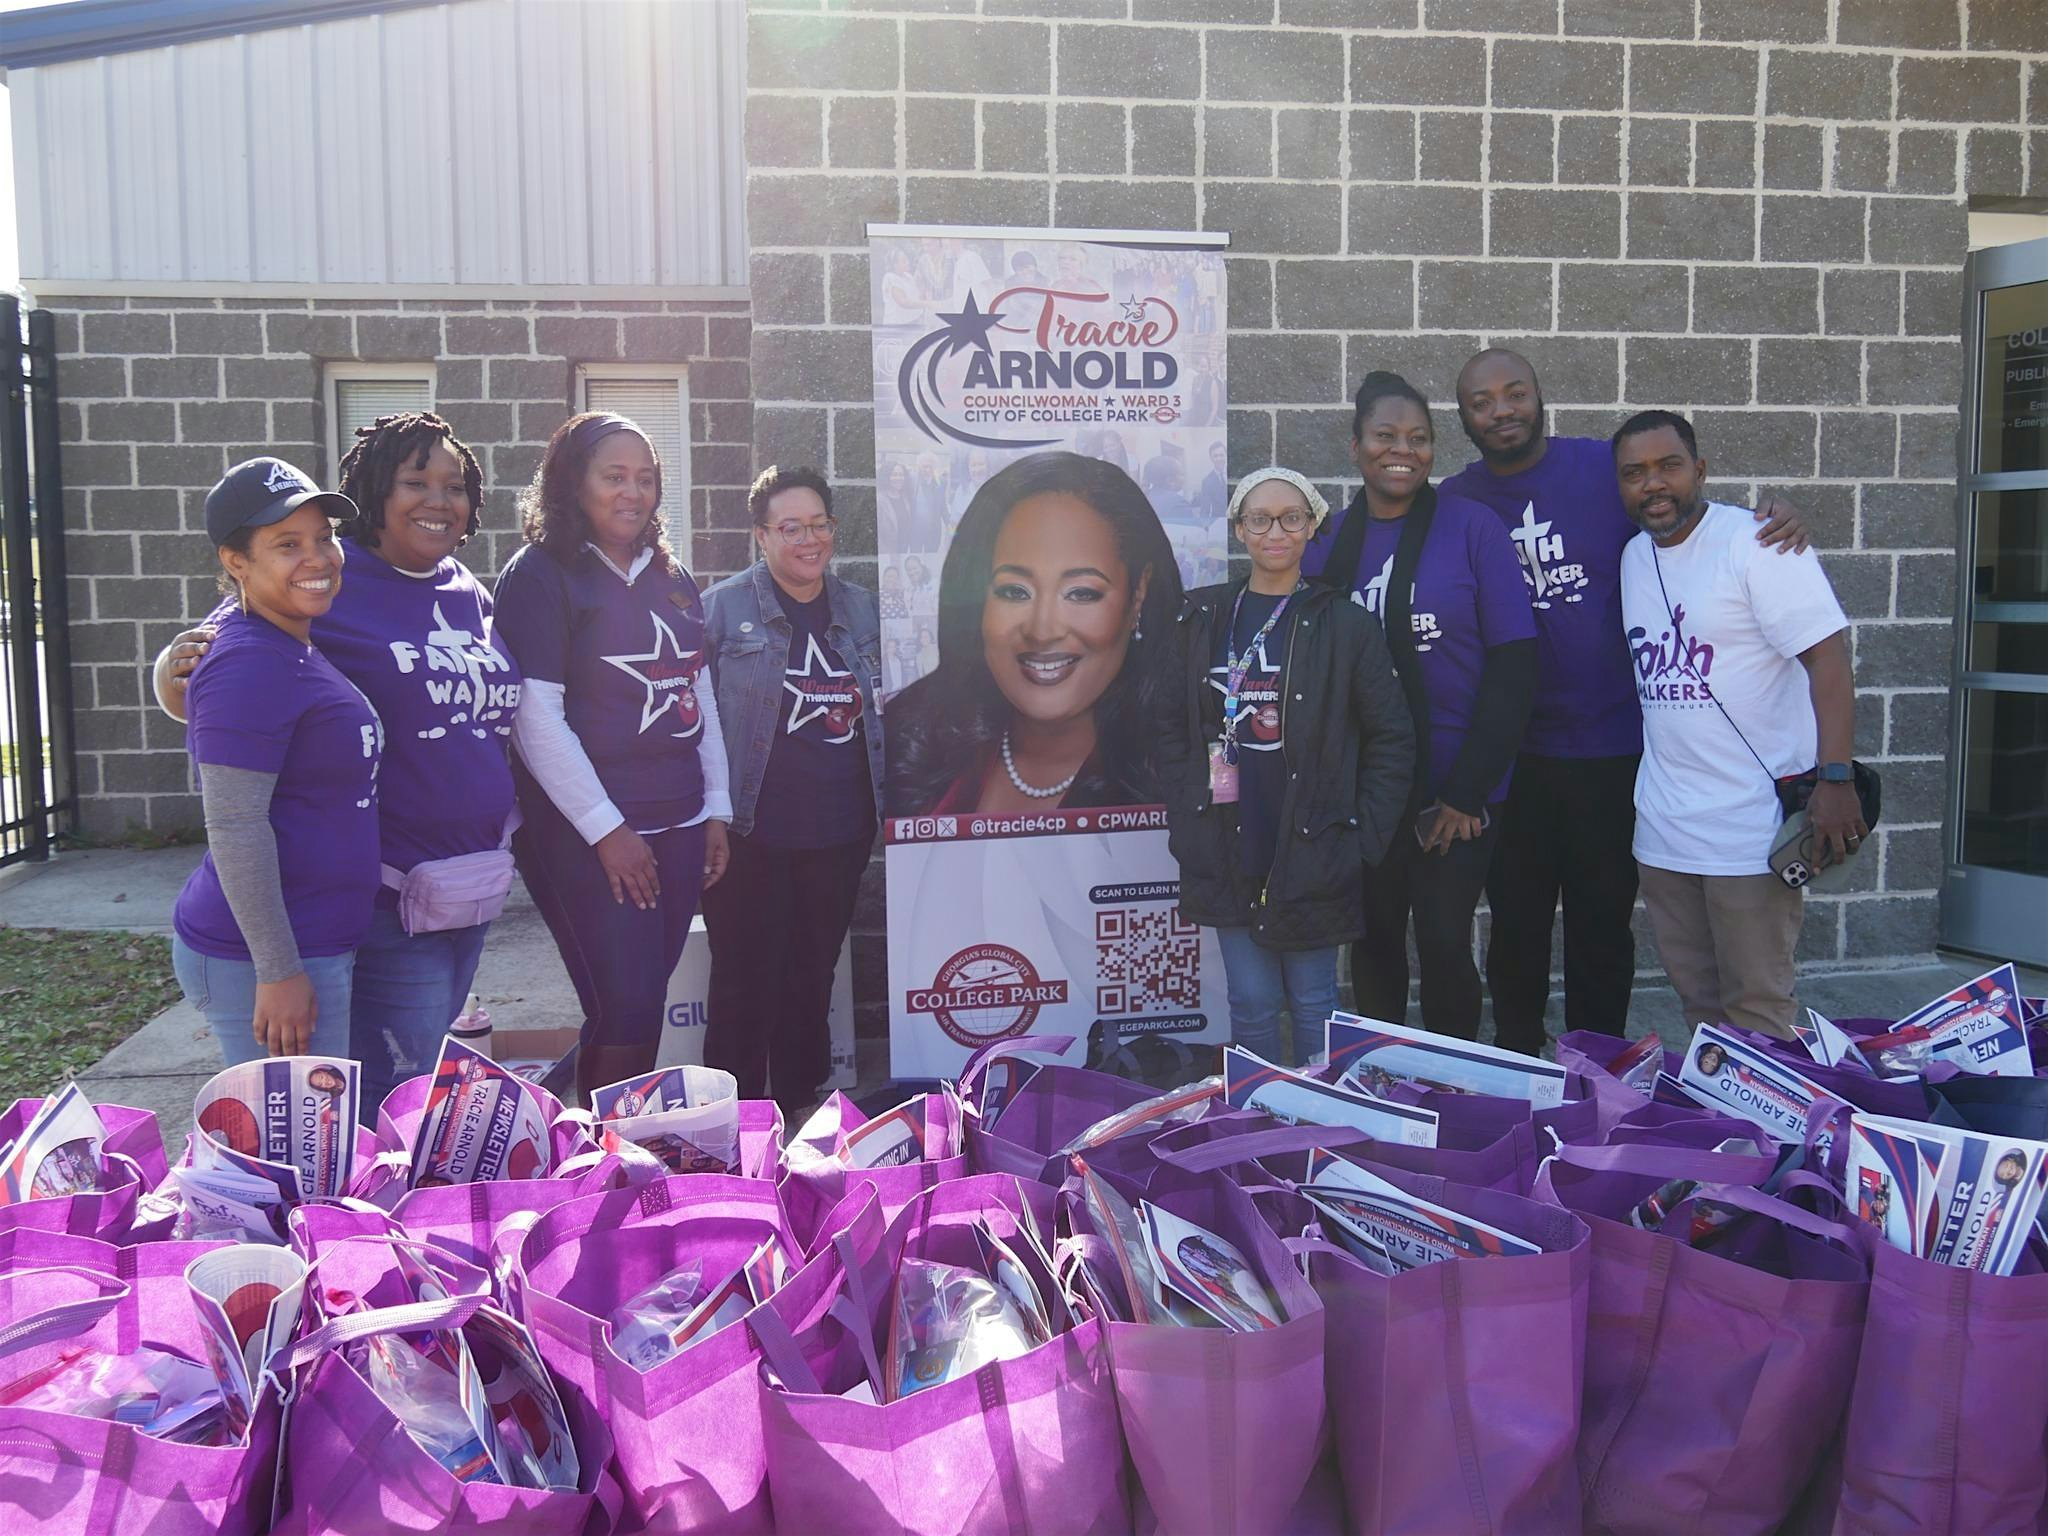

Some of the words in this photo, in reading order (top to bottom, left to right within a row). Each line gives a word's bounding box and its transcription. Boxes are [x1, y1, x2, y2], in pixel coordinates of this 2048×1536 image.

[988, 286, 1179, 354] Tracie
[962, 350, 1179, 390] ARNOLD
[963, 395, 1099, 408] COUNCILWOMAN
[1121, 395, 1169, 408] WARD
[1173, 395, 1182, 408] 3
[964, 409, 1000, 422] CITY
[1004, 409, 1027, 422] OF
[1031, 409, 1102, 422] COLLEGE
[1107, 409, 1149, 422] PARK
[804, 693, 853, 703] THRIVERS
[970, 816, 1066, 836] @tracie4cp
[1095, 889, 1122, 898] SCAN
[1123, 887, 1136, 896] TO
[1138, 885, 1170, 895] LEARN
[981, 949, 1016, 964] GLOBAL
[1015, 960, 1031, 977] CITY
[911, 986, 1005, 1010] COLLEGE
[1010, 985, 1063, 1004] PARK
[1117, 1019, 1200, 1033] EGEPARKGA.COM
[466, 1084, 489, 1124] TRACIE
[1720, 1078, 1785, 1119] ARNOLD
[303, 1096, 316, 1165] ARNOLD
[450, 1123, 475, 1175] ARNOLD
[899, 1142, 909, 1162] IN
